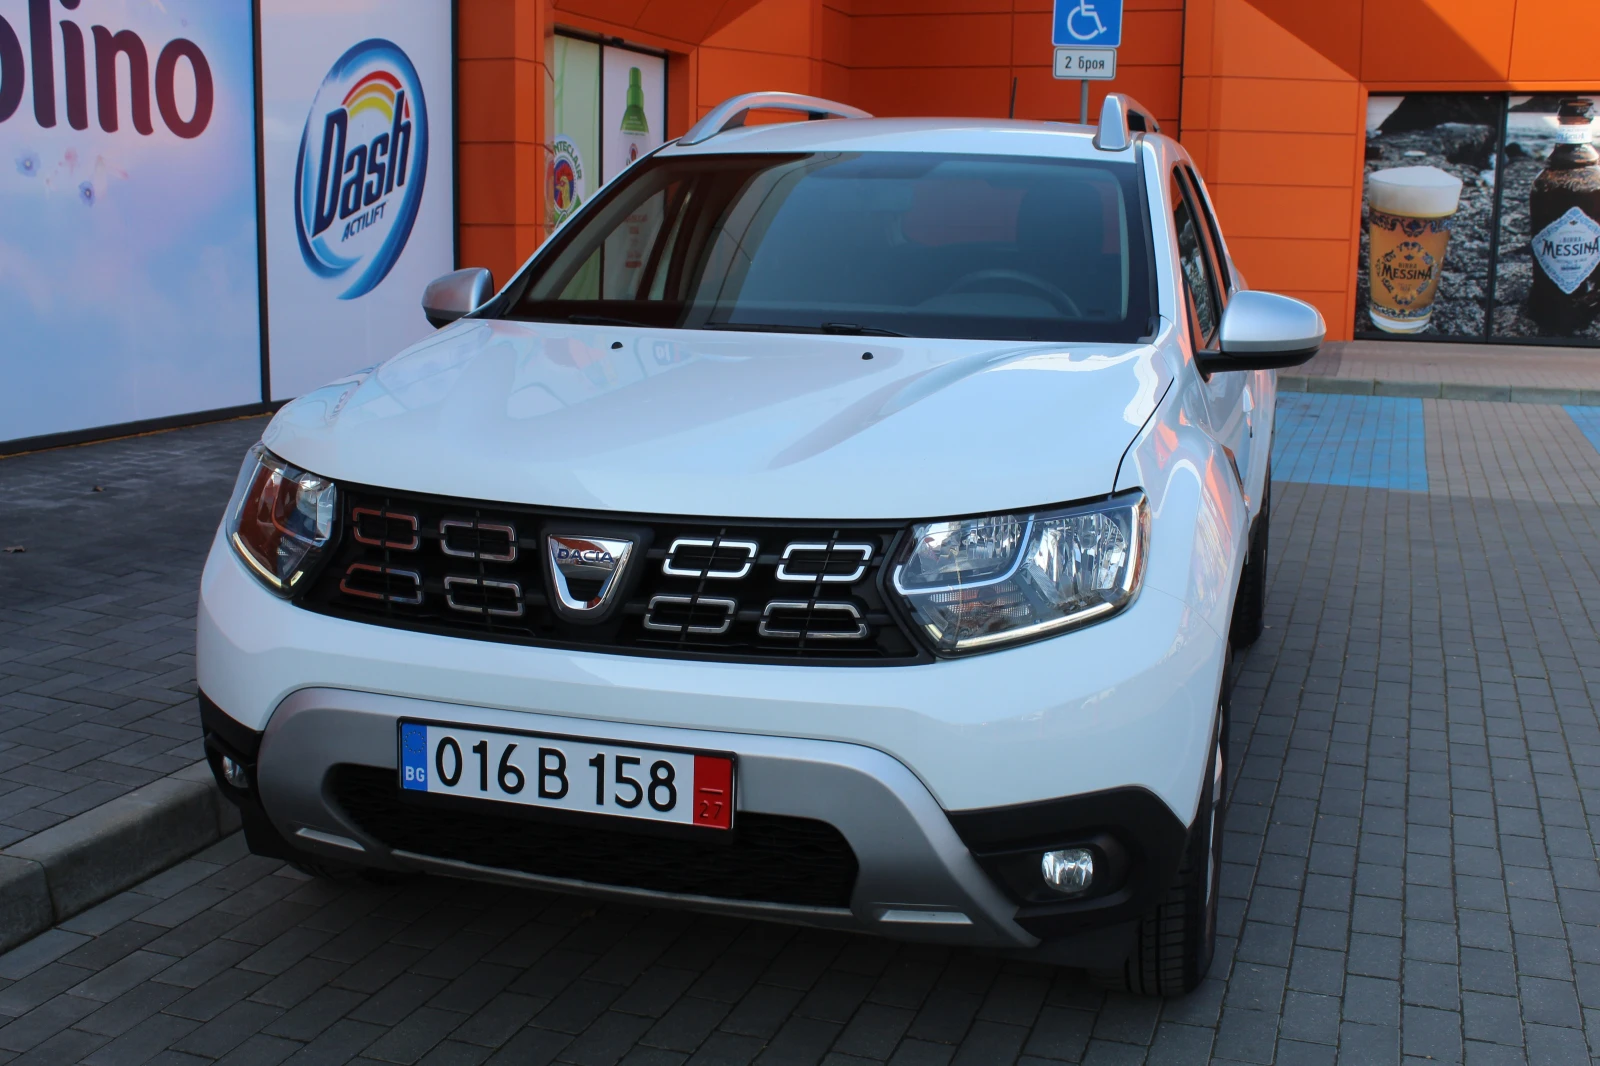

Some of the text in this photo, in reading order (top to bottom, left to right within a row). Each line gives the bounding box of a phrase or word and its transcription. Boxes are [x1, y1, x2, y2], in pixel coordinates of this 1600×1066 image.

[1065, 56, 1105, 72] 2 броя
[311, 89, 412, 238] Dash
[341, 201, 387, 242] ACTILIFT
[1542, 236, 1600, 259] MESSINA
[1381, 262, 1433, 280] MESSINA
[557, 548, 615, 563] DACIA
[405, 766, 426, 783] BG
[588, 753, 678, 812] 158
[699, 800, 723, 820] 27
